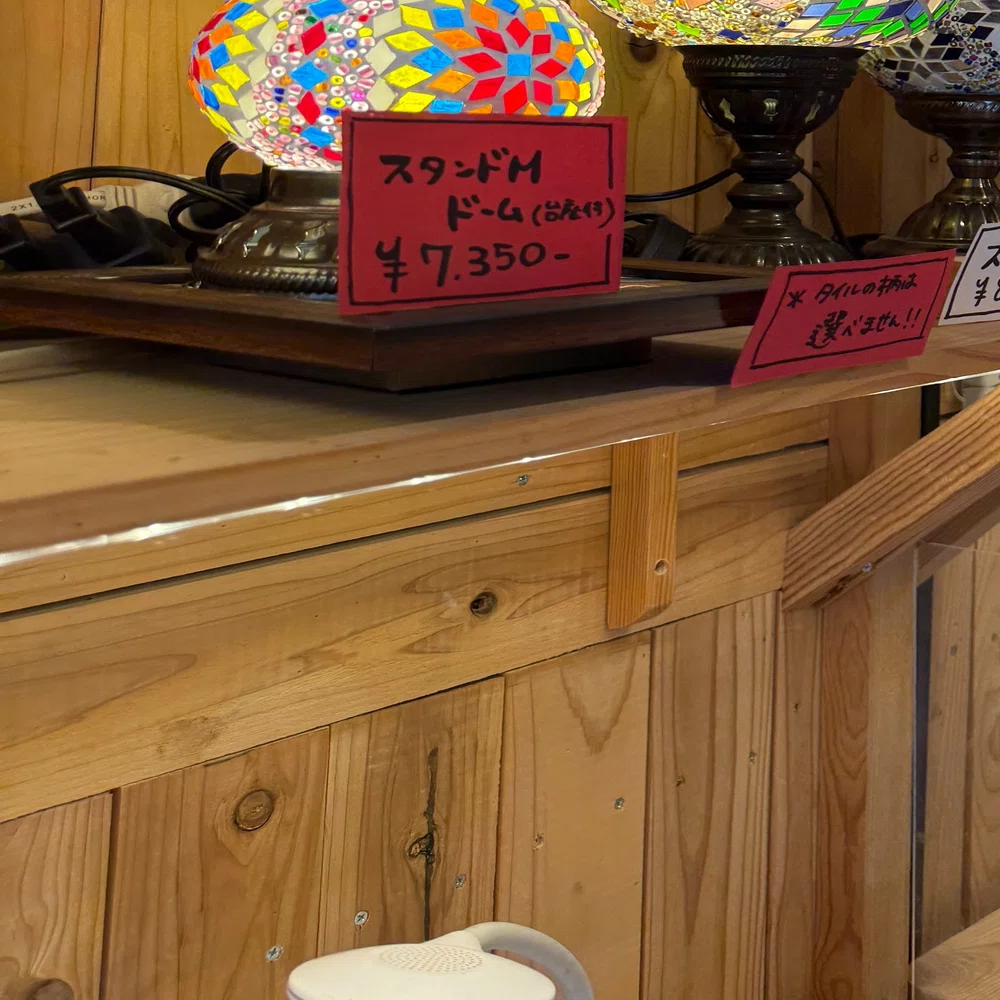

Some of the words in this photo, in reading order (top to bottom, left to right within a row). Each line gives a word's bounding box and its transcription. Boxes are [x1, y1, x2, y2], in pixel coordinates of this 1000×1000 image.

[378, 147, 543, 185] スタンドM
[374, 236, 571, 293] ¥7.350-
